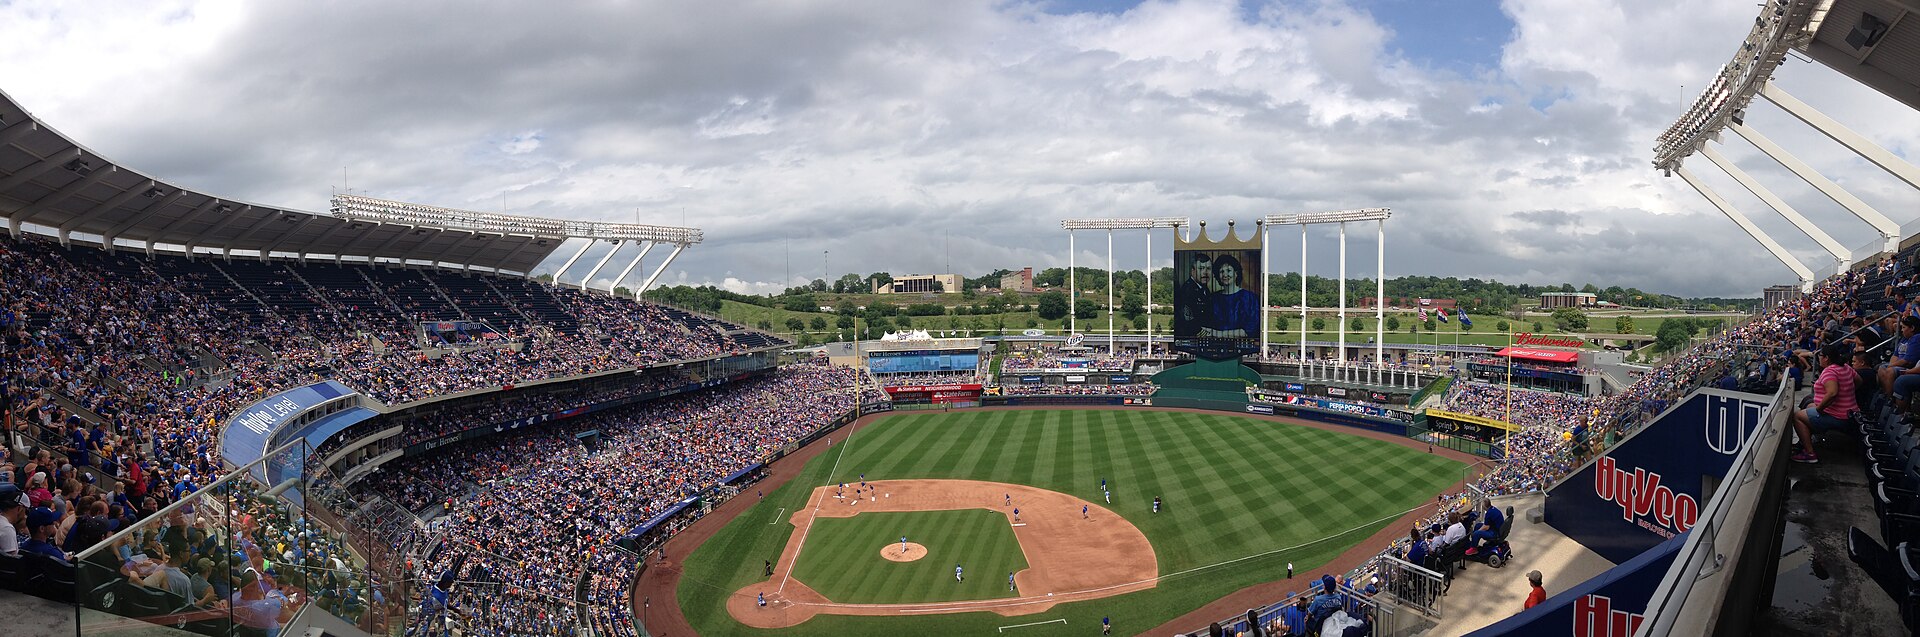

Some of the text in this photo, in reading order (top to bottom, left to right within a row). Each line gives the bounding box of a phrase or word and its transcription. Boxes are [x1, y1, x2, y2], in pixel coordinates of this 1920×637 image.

[1514, 332, 1584, 347] Budweiser
[263, 395, 300, 417] Level
[1435, 420, 1453, 431] Sprint
[1463, 423, 1476, 432] Sprint
[1595, 455, 1698, 534] HyVee
